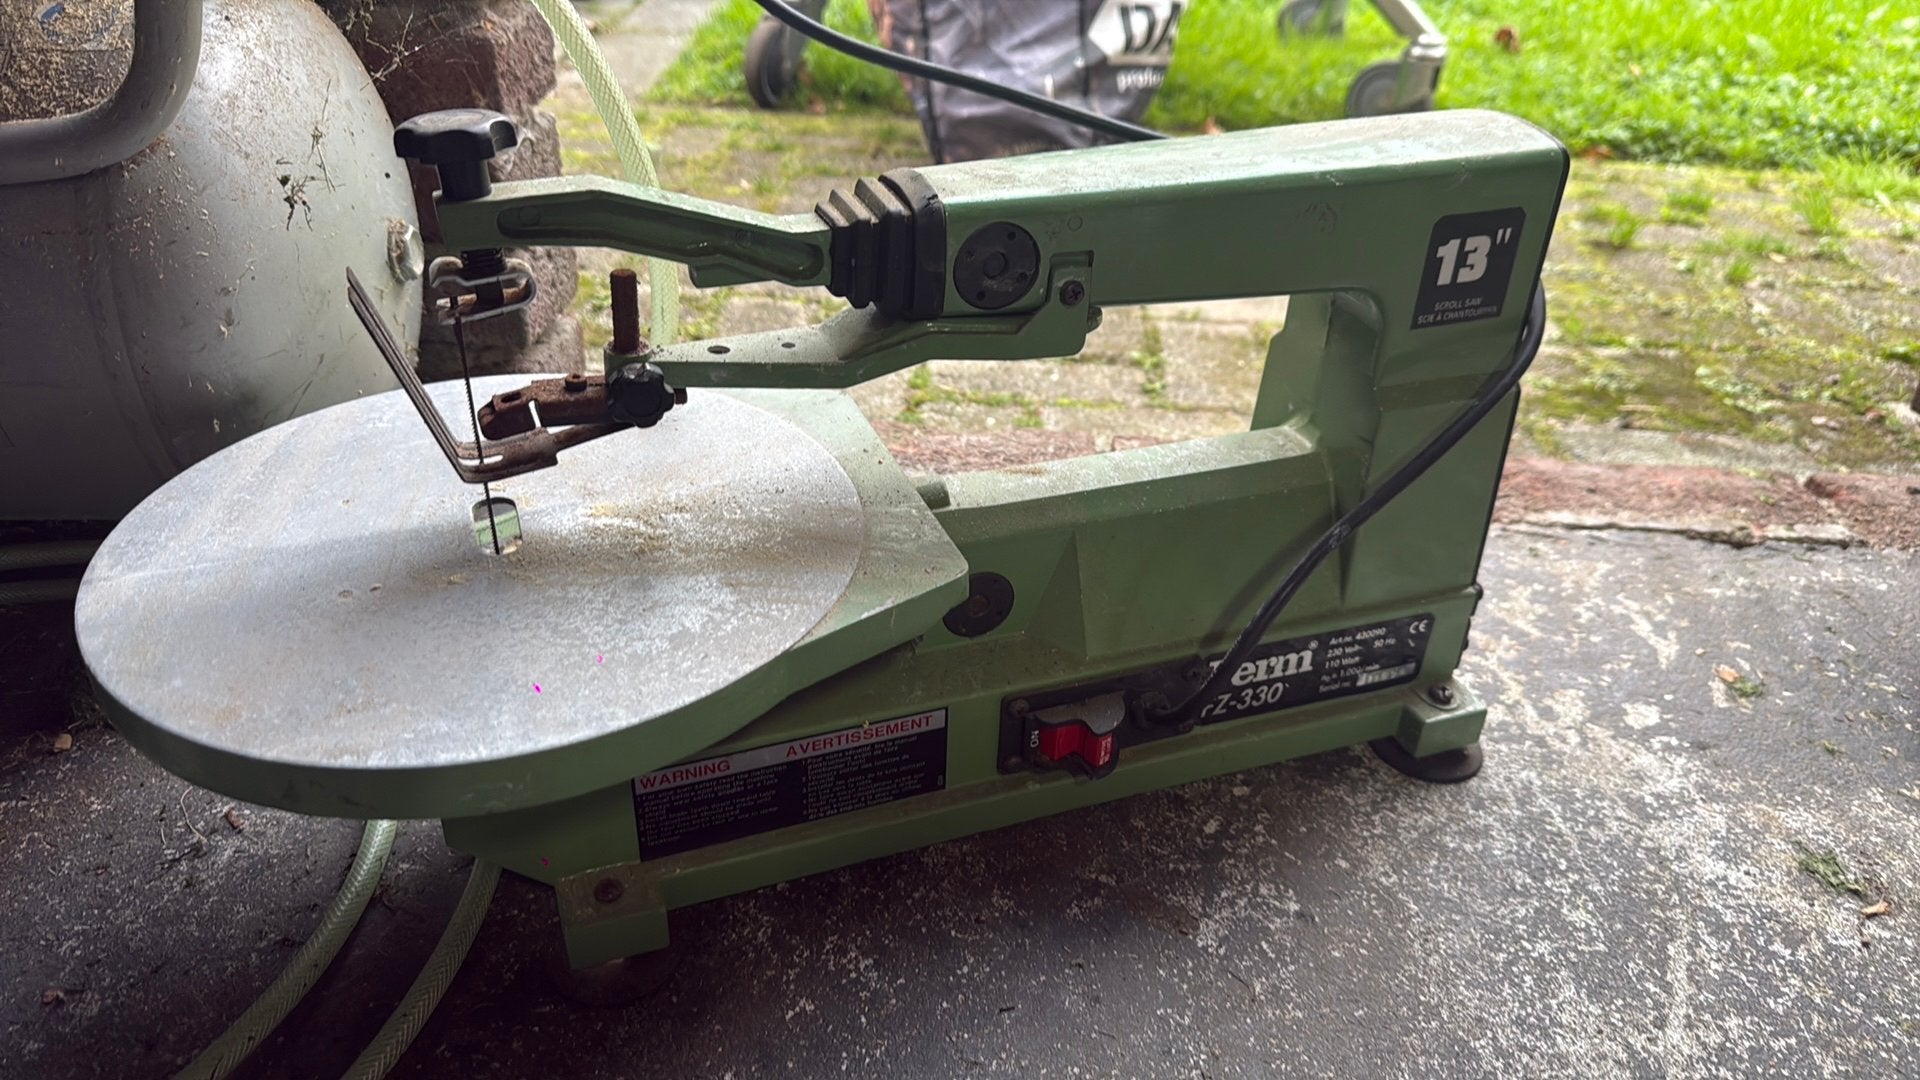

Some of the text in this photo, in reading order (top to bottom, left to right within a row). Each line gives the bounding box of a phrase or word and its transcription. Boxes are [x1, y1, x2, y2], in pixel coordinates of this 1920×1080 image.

[1436, 227, 1512, 286] 13"
[1434, 297, 1484, 311] SCROLL SAW
[1327, 647, 1343, 658] 230
[639, 714, 934, 790] WARNING AVERTISSEMENT
